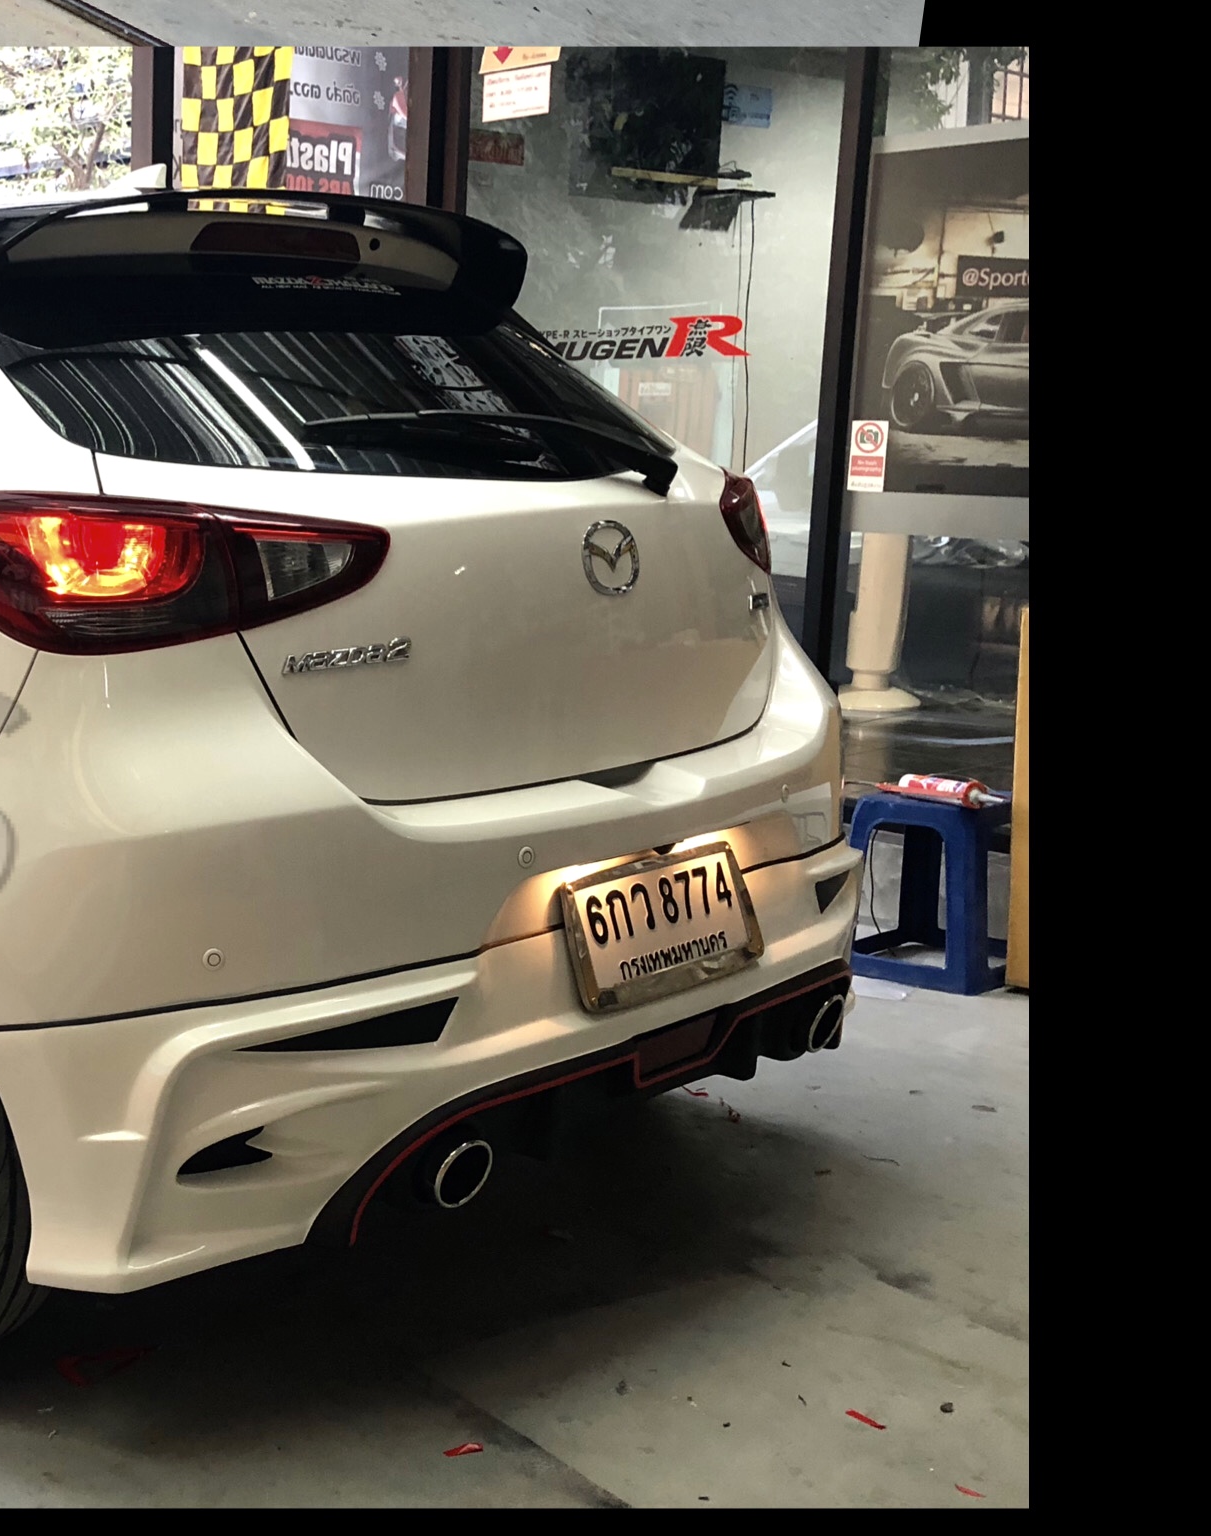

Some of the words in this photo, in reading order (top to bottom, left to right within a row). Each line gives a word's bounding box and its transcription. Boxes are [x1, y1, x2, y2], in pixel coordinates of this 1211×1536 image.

[962, 267, 1029, 291] @Sport
[541, 328, 570, 340] YPE-R
[585, 882, 656, 945] 6กว
[658, 861, 732, 924] 8774
[619, 931, 728, 981] กรงเทพมหานคร
